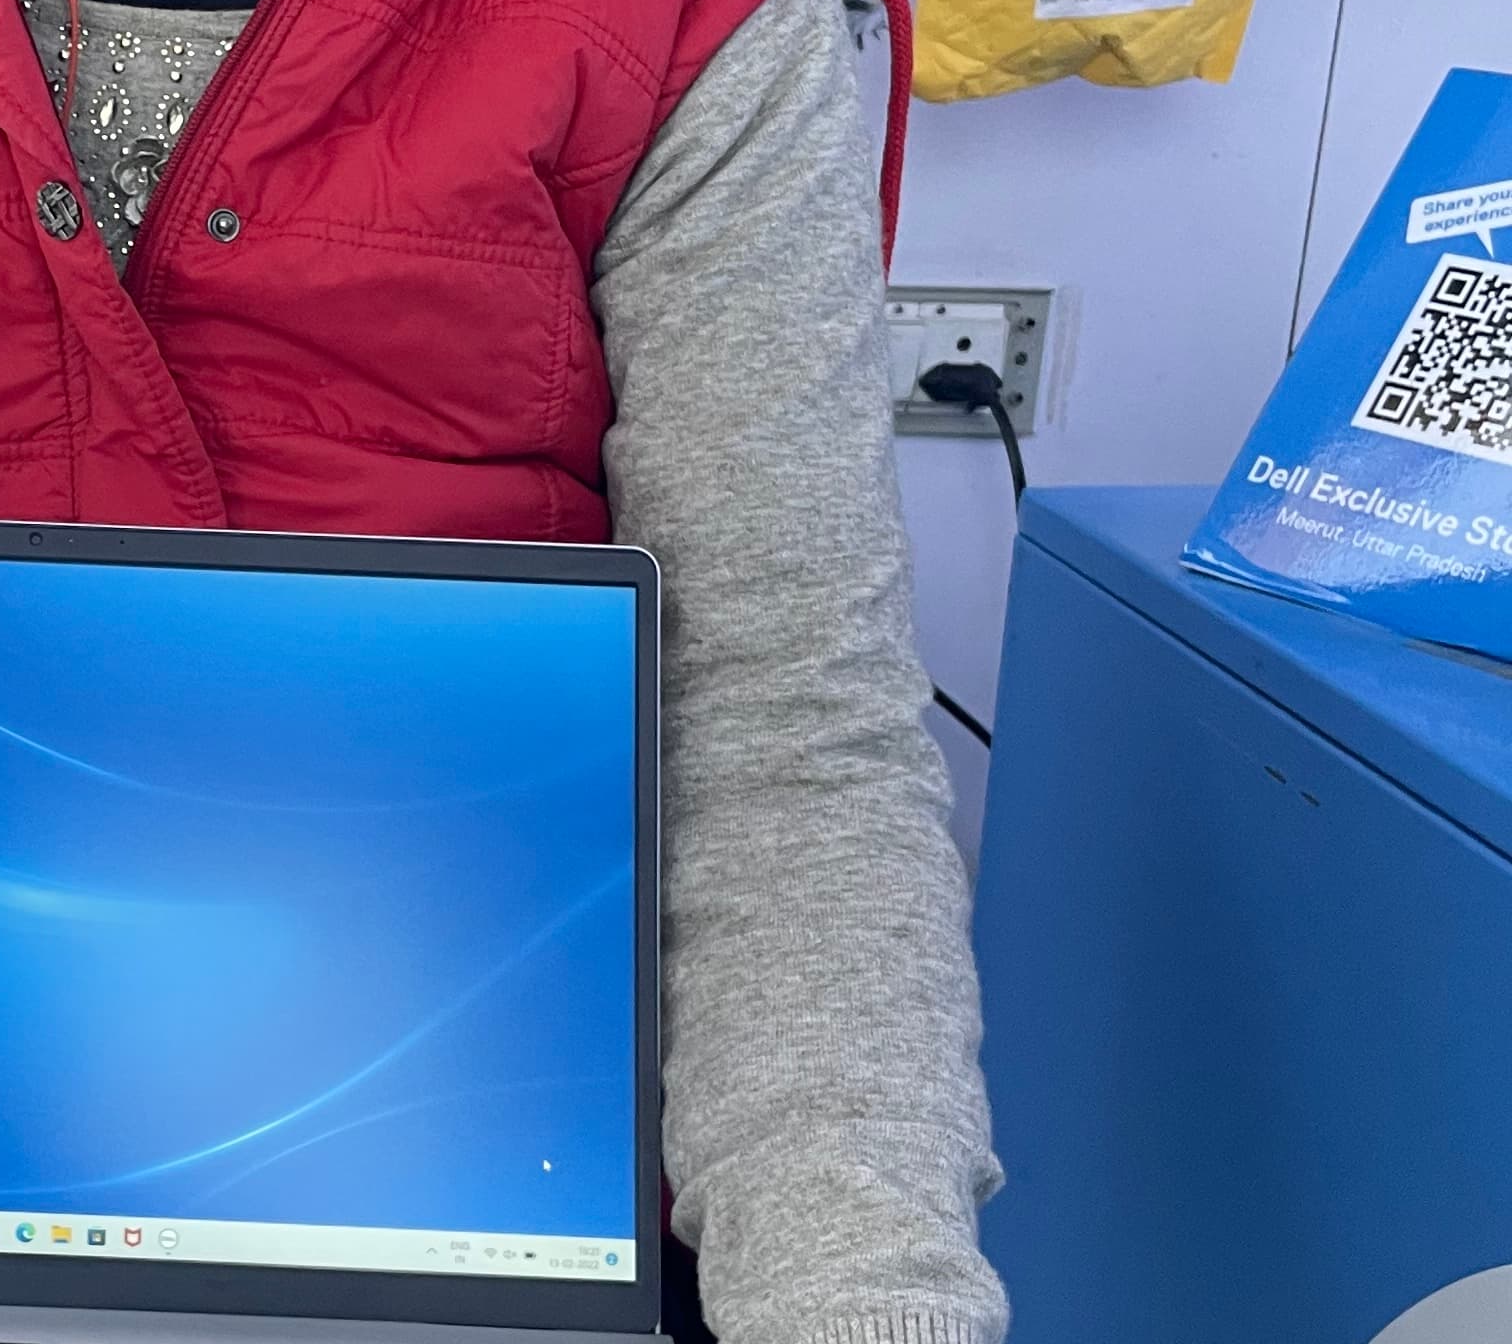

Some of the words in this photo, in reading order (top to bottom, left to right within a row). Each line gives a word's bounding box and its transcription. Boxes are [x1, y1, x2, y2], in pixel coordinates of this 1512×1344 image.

[1424, 197, 1473, 216] Share
[1247, 455, 1310, 494] Dell
[1310, 472, 1458, 536] Exclusive
[1352, 529, 1405, 558] Uttar
[1407, 543, 1487, 584] Pradesh
